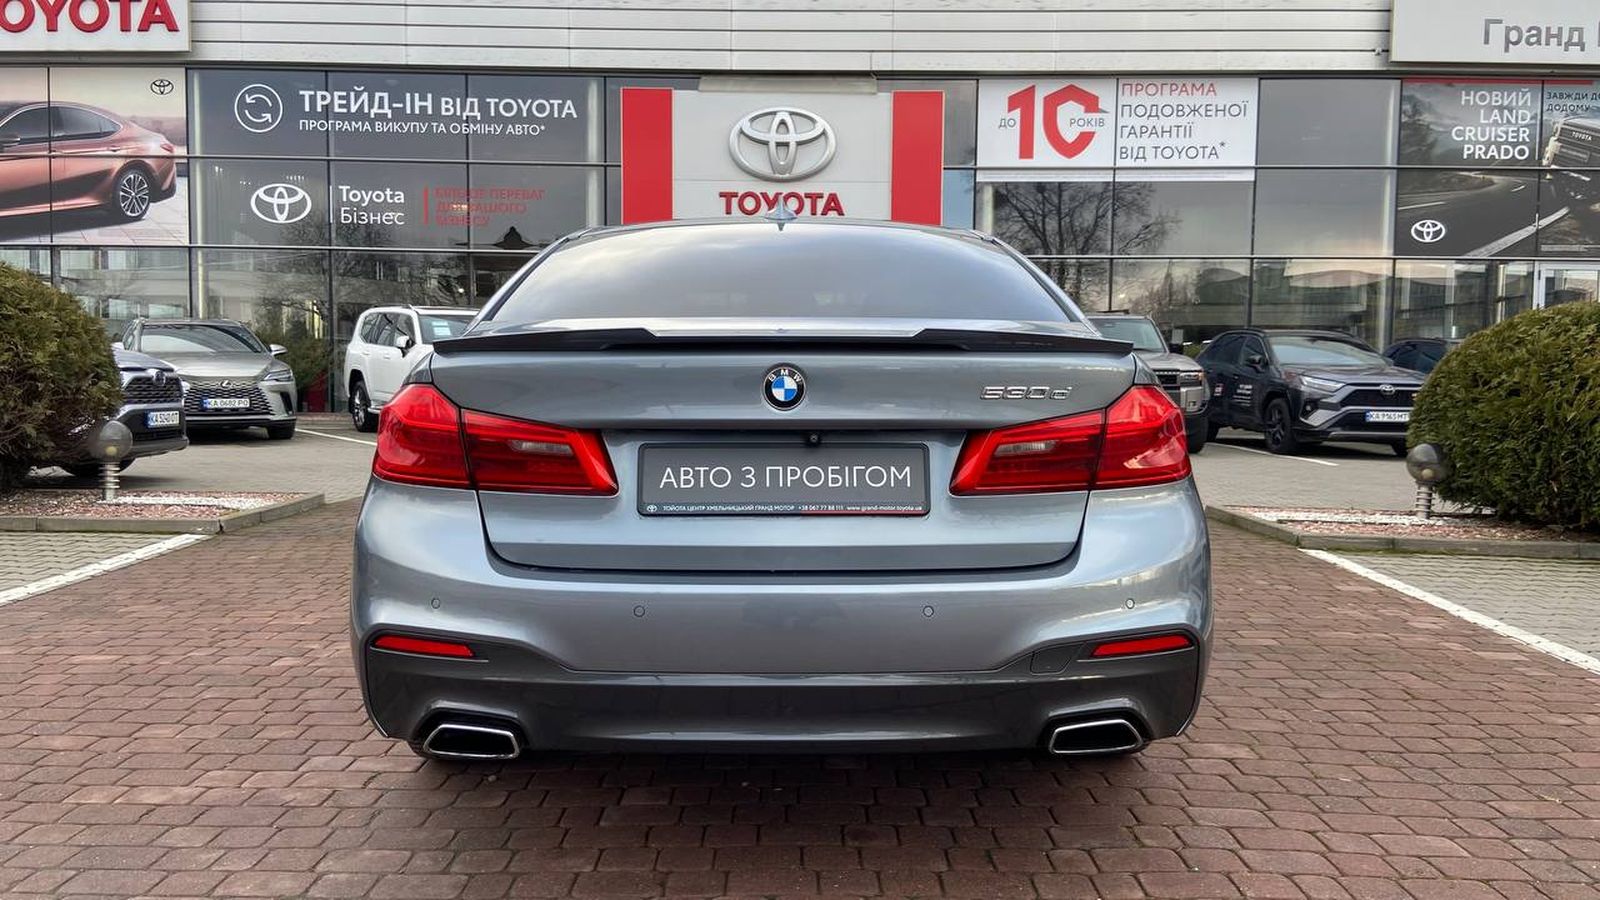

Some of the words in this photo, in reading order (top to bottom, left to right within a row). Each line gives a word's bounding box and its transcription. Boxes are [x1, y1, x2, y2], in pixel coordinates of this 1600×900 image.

[1483, 18, 1586, 53] Гранд
[1121, 81, 1217, 97] ПРОГРАМА
[1461, 88, 1531, 107] НОВИЙ
[1546, 92, 1588, 100] ЗАВЖДИ
[299, 86, 433, 119] ТРЕЙД-ІН
[440, 97, 481, 121] ВІД
[486, 98, 578, 119] TOYOTA
[1120, 101, 1249, 121] ПОДОВЖЕНОЇ
[1547, 104, 1590, 112] ДОДОМУ
[998, 117, 1017, 130] ДО
[1069, 117, 1105, 128] РОКІВ
[1480, 109, 1531, 124] LAND
[299, 119, 371, 133] ПРОГРАМА
[375, 121, 428, 134] ВИКУПУ
[430, 121, 446, 134] ТА
[449, 122, 503, 136] ОБМІНУ
[1120, 121, 1194, 139] ГАРАНТІЇ
[1452, 126, 1530, 142] CRUISER
[1119, 146, 1147, 162] ВІД
[1463, 144, 1530, 160] PRADO
[338, 185, 405, 207] Toyota
[720, 191, 845, 216] TOYOTA
[340, 206, 405, 226] Бізнес
[768, 368, 802, 382] BMW
[659, 466, 732, 489] АВТО
[740, 466, 756, 488] З
[765, 466, 911, 488] ПРОБІГОМ
